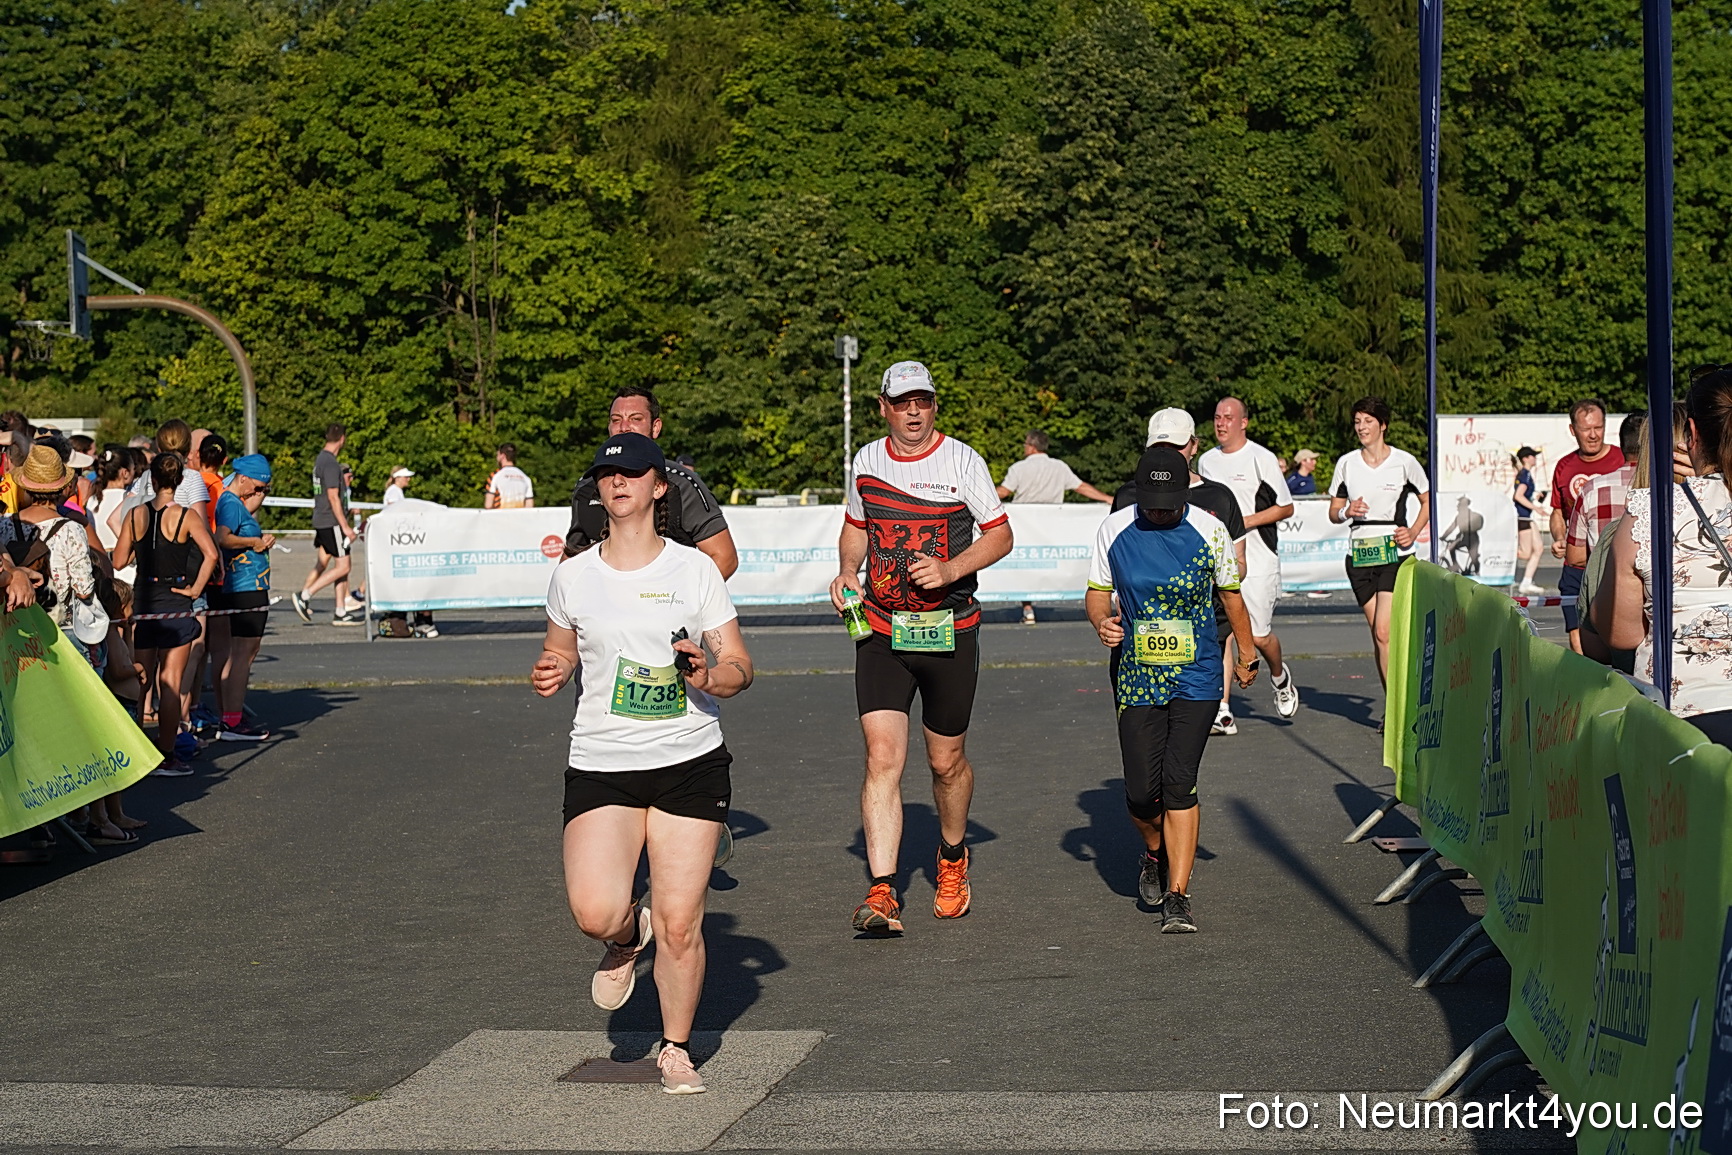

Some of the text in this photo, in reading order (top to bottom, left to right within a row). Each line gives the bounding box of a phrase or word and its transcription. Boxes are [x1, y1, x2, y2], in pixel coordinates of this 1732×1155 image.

[910, 482, 950, 492] NEUMARKT
[1278, 520, 1303, 533] OW
[390, 532, 426, 546] NOW
[1029, 547, 1040, 559] &
[1279, 542, 1319, 553] -BIKES
[1357, 546, 1380, 558] 1969
[394, 550, 543, 568] E-BIKES & FAHRRÄDER
[746, 550, 757, 562] &
[907, 626, 939, 640] 116
[1147, 635, 1179, 651] 699
[615, 684, 625, 705] RUN
[626, 681, 678, 703] 1738
[629, 701, 672, 711] Wein Katrin
